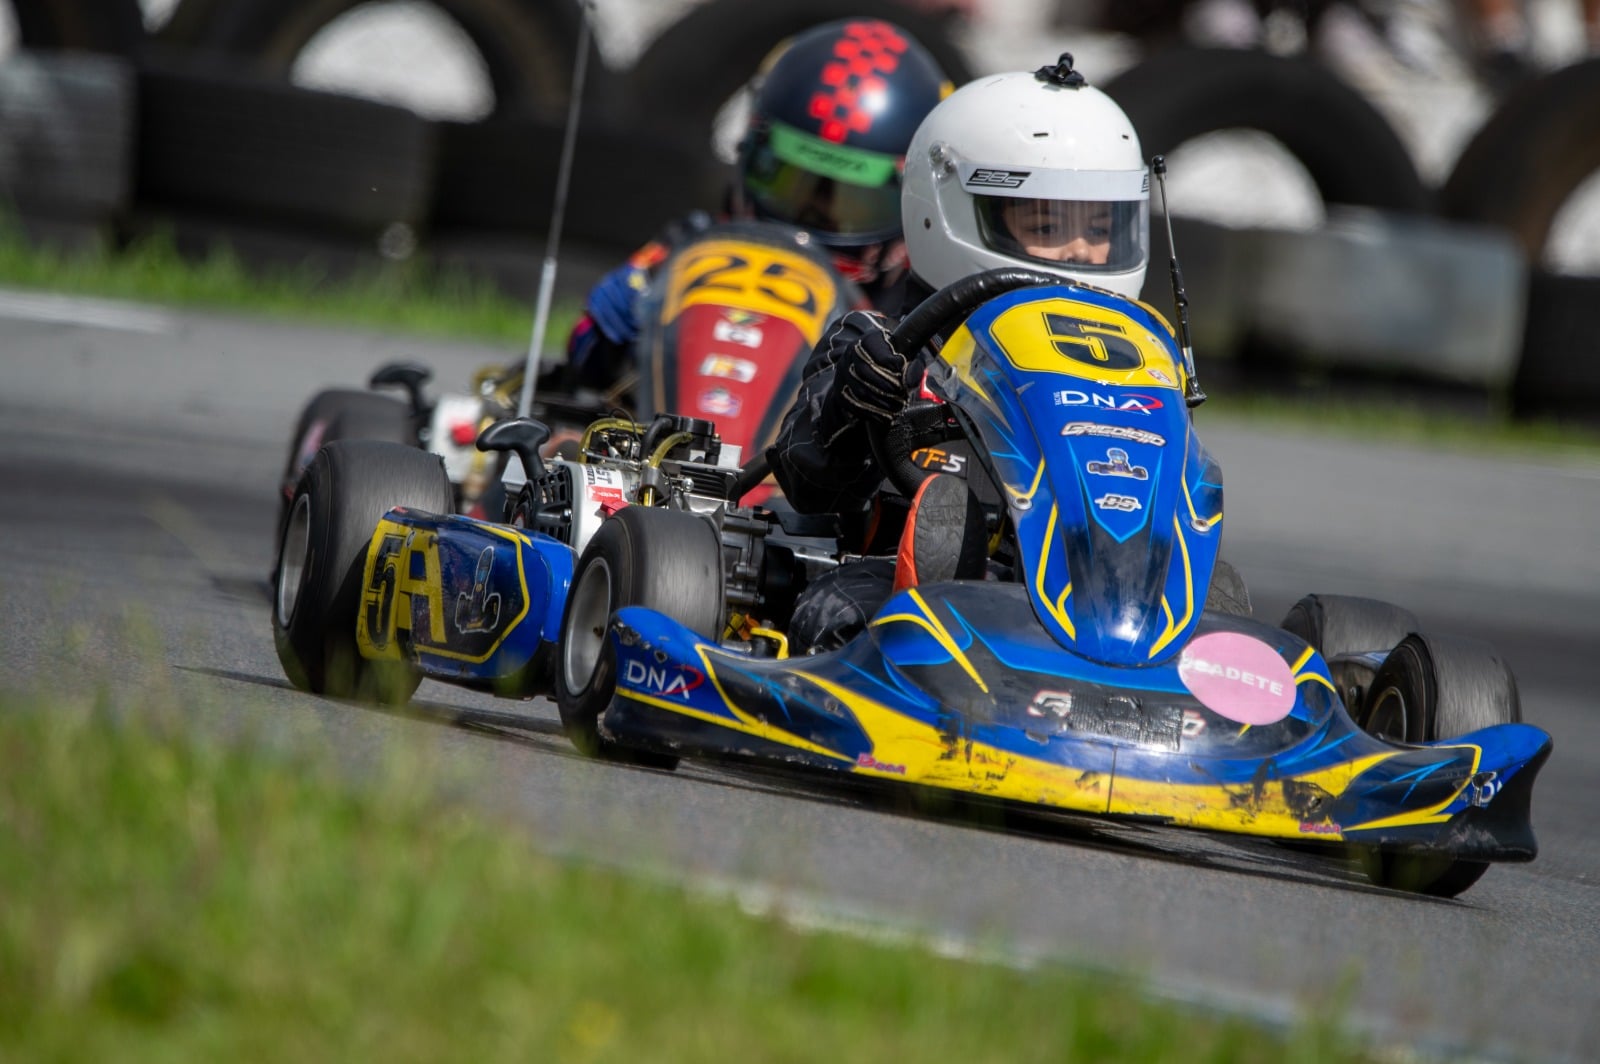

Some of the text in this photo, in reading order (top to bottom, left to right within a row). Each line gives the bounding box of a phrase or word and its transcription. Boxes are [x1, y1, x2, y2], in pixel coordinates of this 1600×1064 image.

[682, 253, 816, 315] 25
[1043, 311, 1145, 372] 5
[1060, 390, 1152, 415] DNA
[626, 658, 691, 700] DNA
